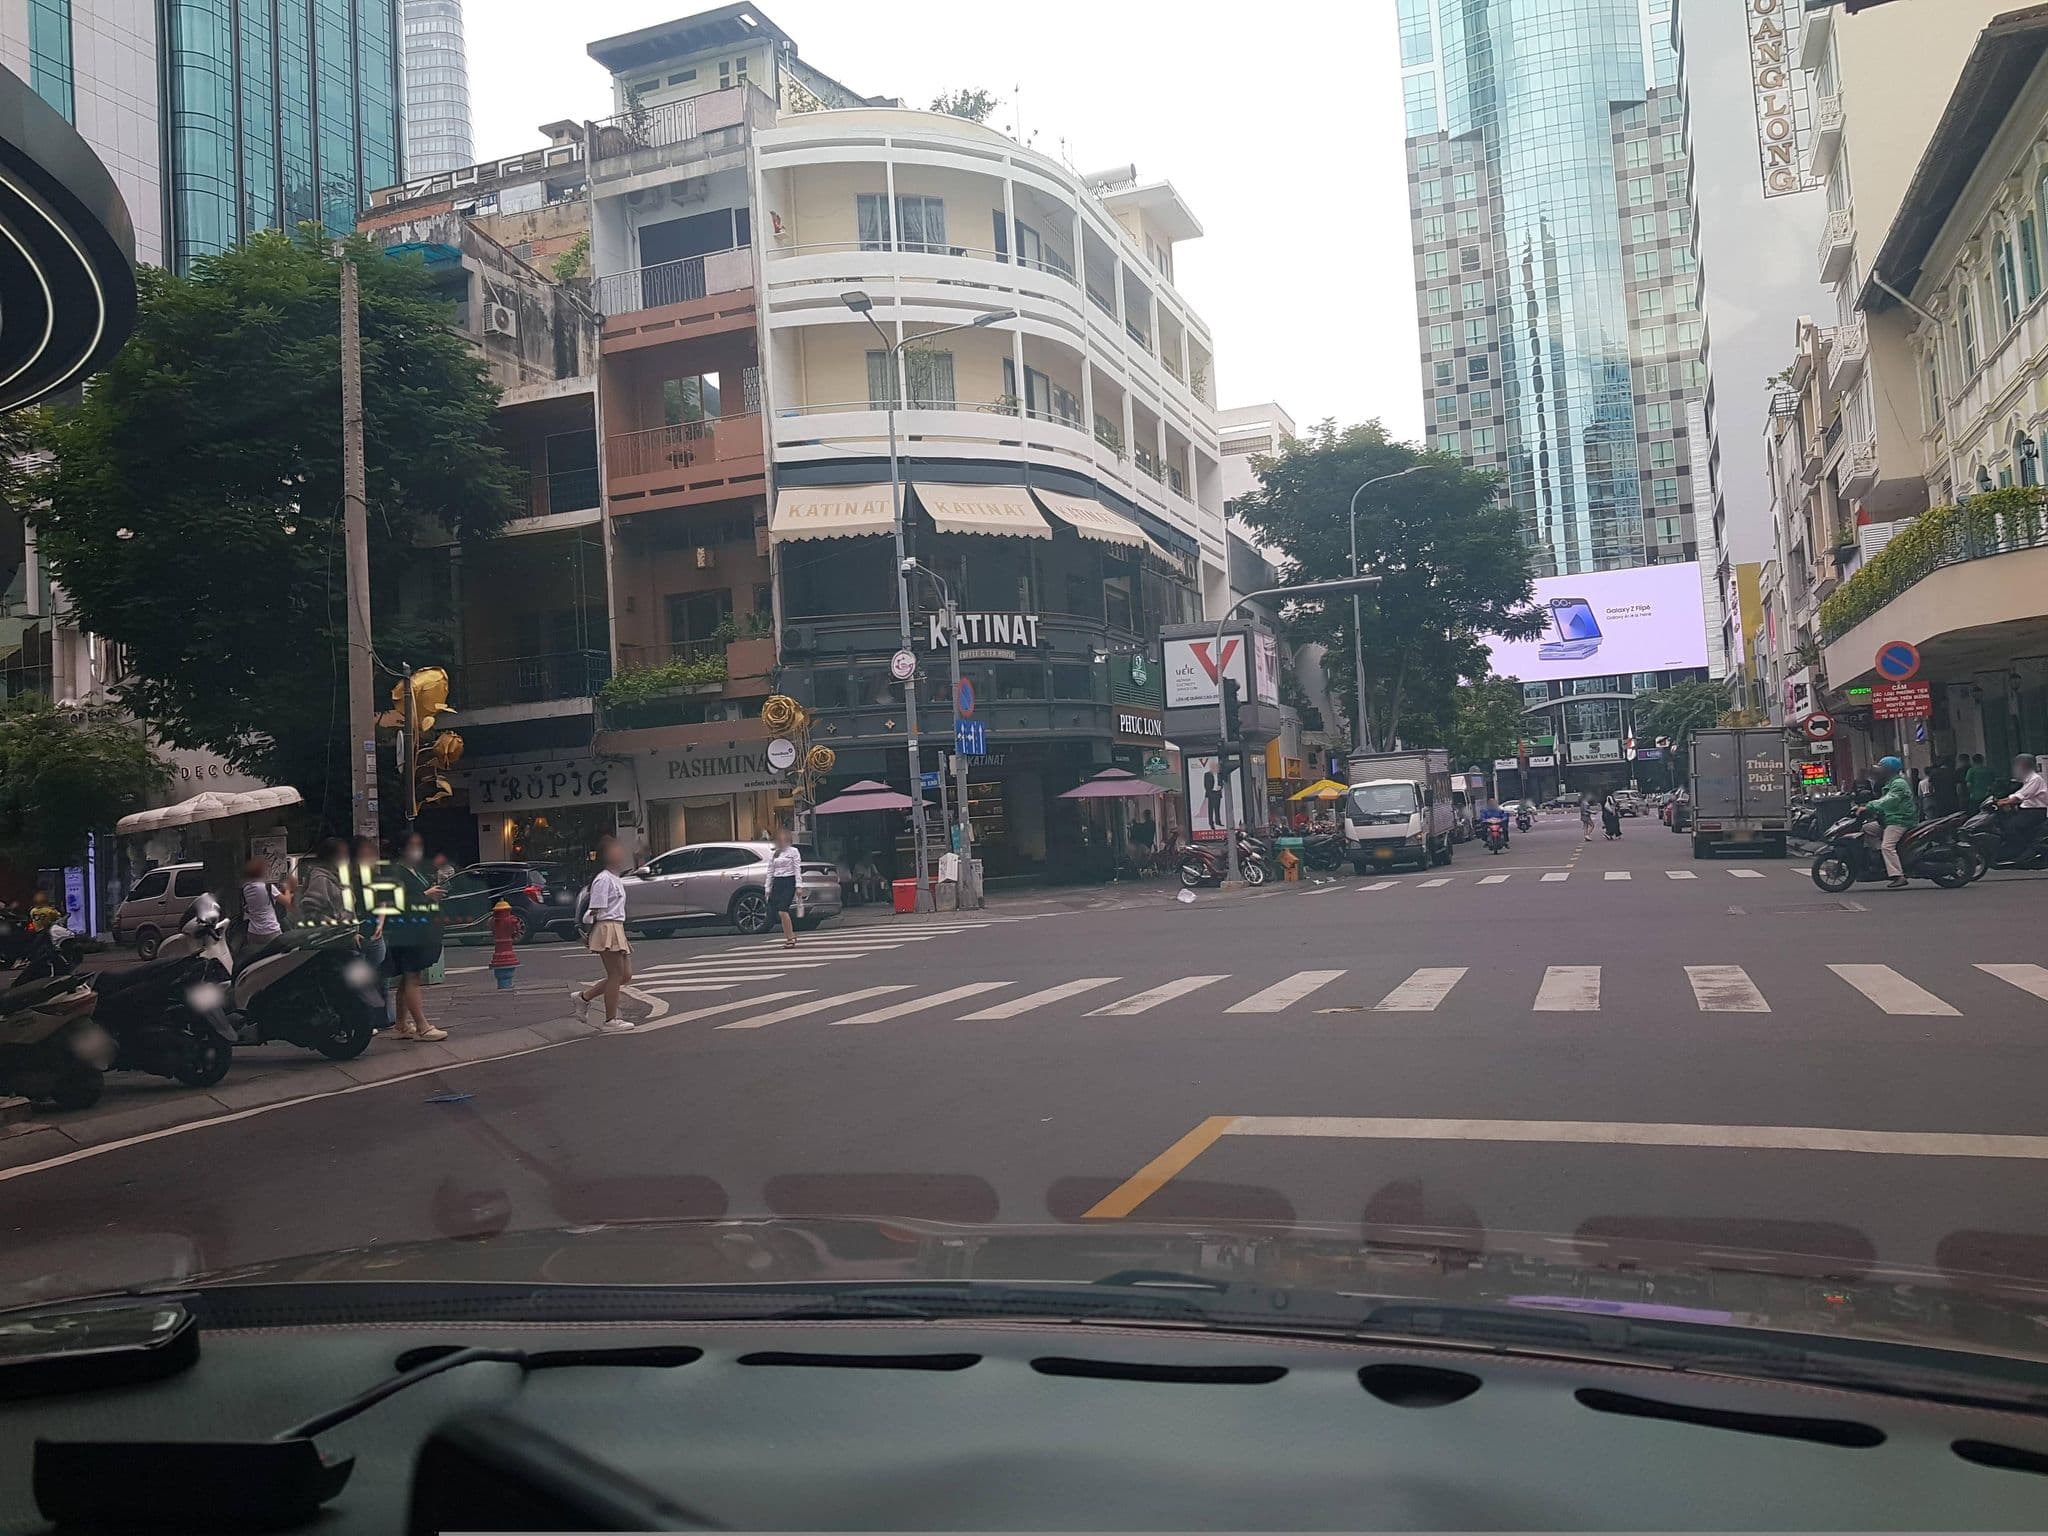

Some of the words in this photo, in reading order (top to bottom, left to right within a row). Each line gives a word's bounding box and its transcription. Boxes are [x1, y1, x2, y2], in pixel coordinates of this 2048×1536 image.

[788, 500, 891, 518] KATINAT
[934, 500, 1025, 518] KATINAT
[1635, 604, 1651, 612] Flip6
[929, 614, 1039, 650] KATINAT
[1119, 714, 1144, 735] PHUC
[968, 754, 1005, 767] KATINAT
